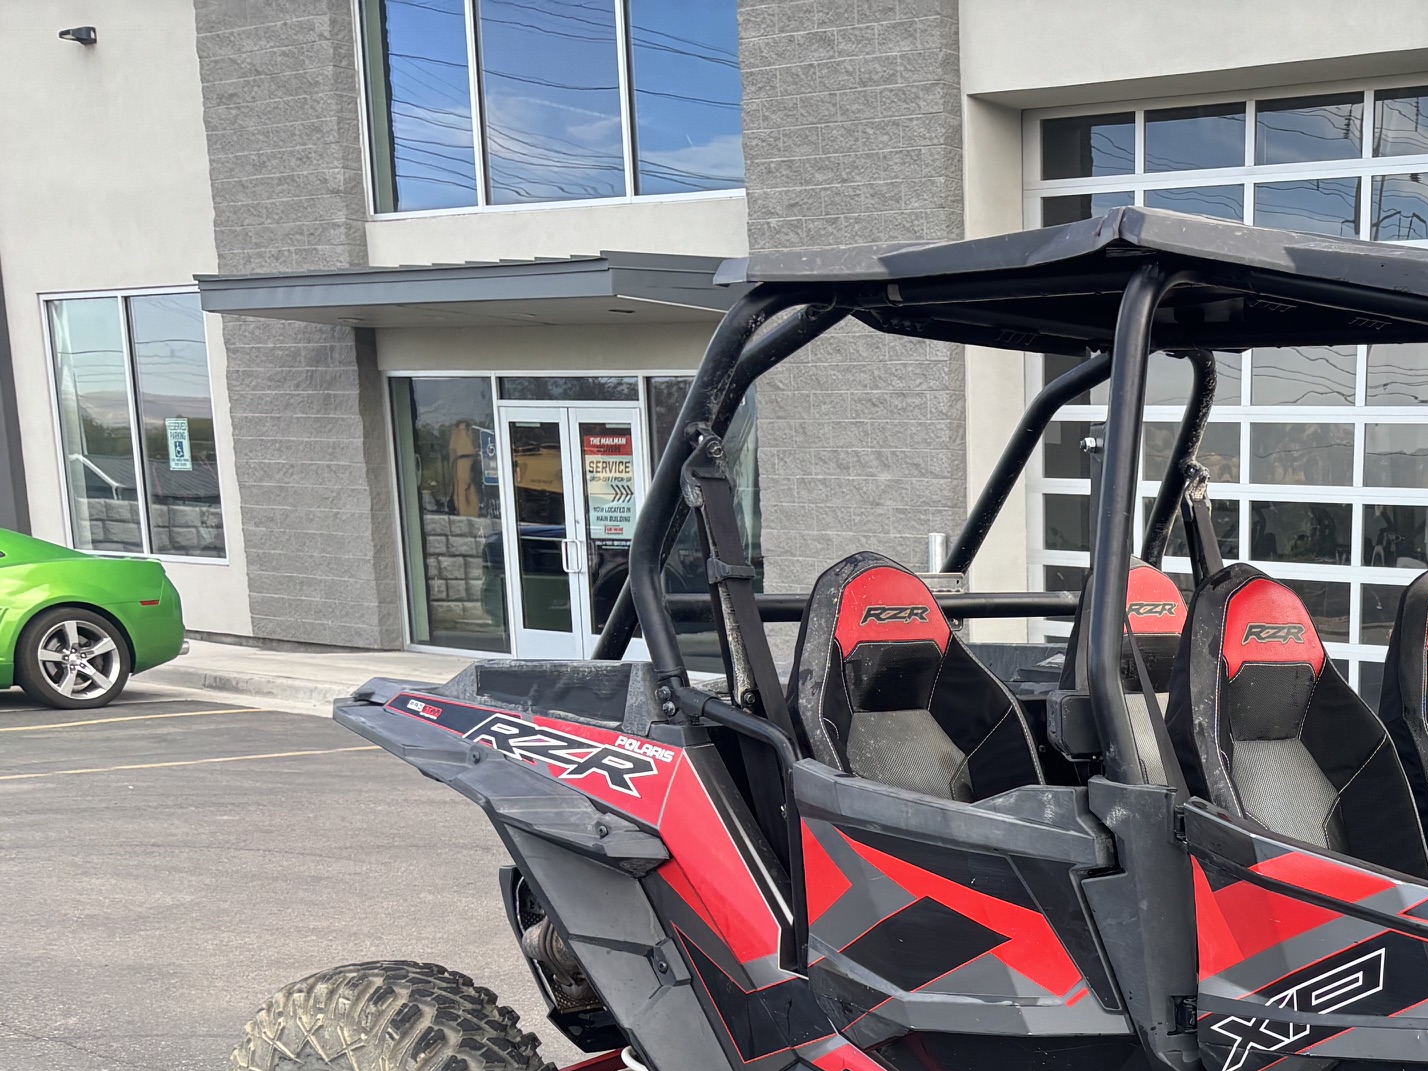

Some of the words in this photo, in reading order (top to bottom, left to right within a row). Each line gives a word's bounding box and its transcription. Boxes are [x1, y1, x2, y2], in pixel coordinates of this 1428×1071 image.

[590, 437, 600, 445] THE
[601, 437, 627, 445] MAILMAN
[588, 461, 631, 474] SERVICE
[859, 605, 931, 627] RZR
[1127, 602, 1179, 617] RZR
[1241, 622, 1306, 646] RZR
[462, 713, 659, 798] RZR
[615, 736, 675, 764] POLARIS
